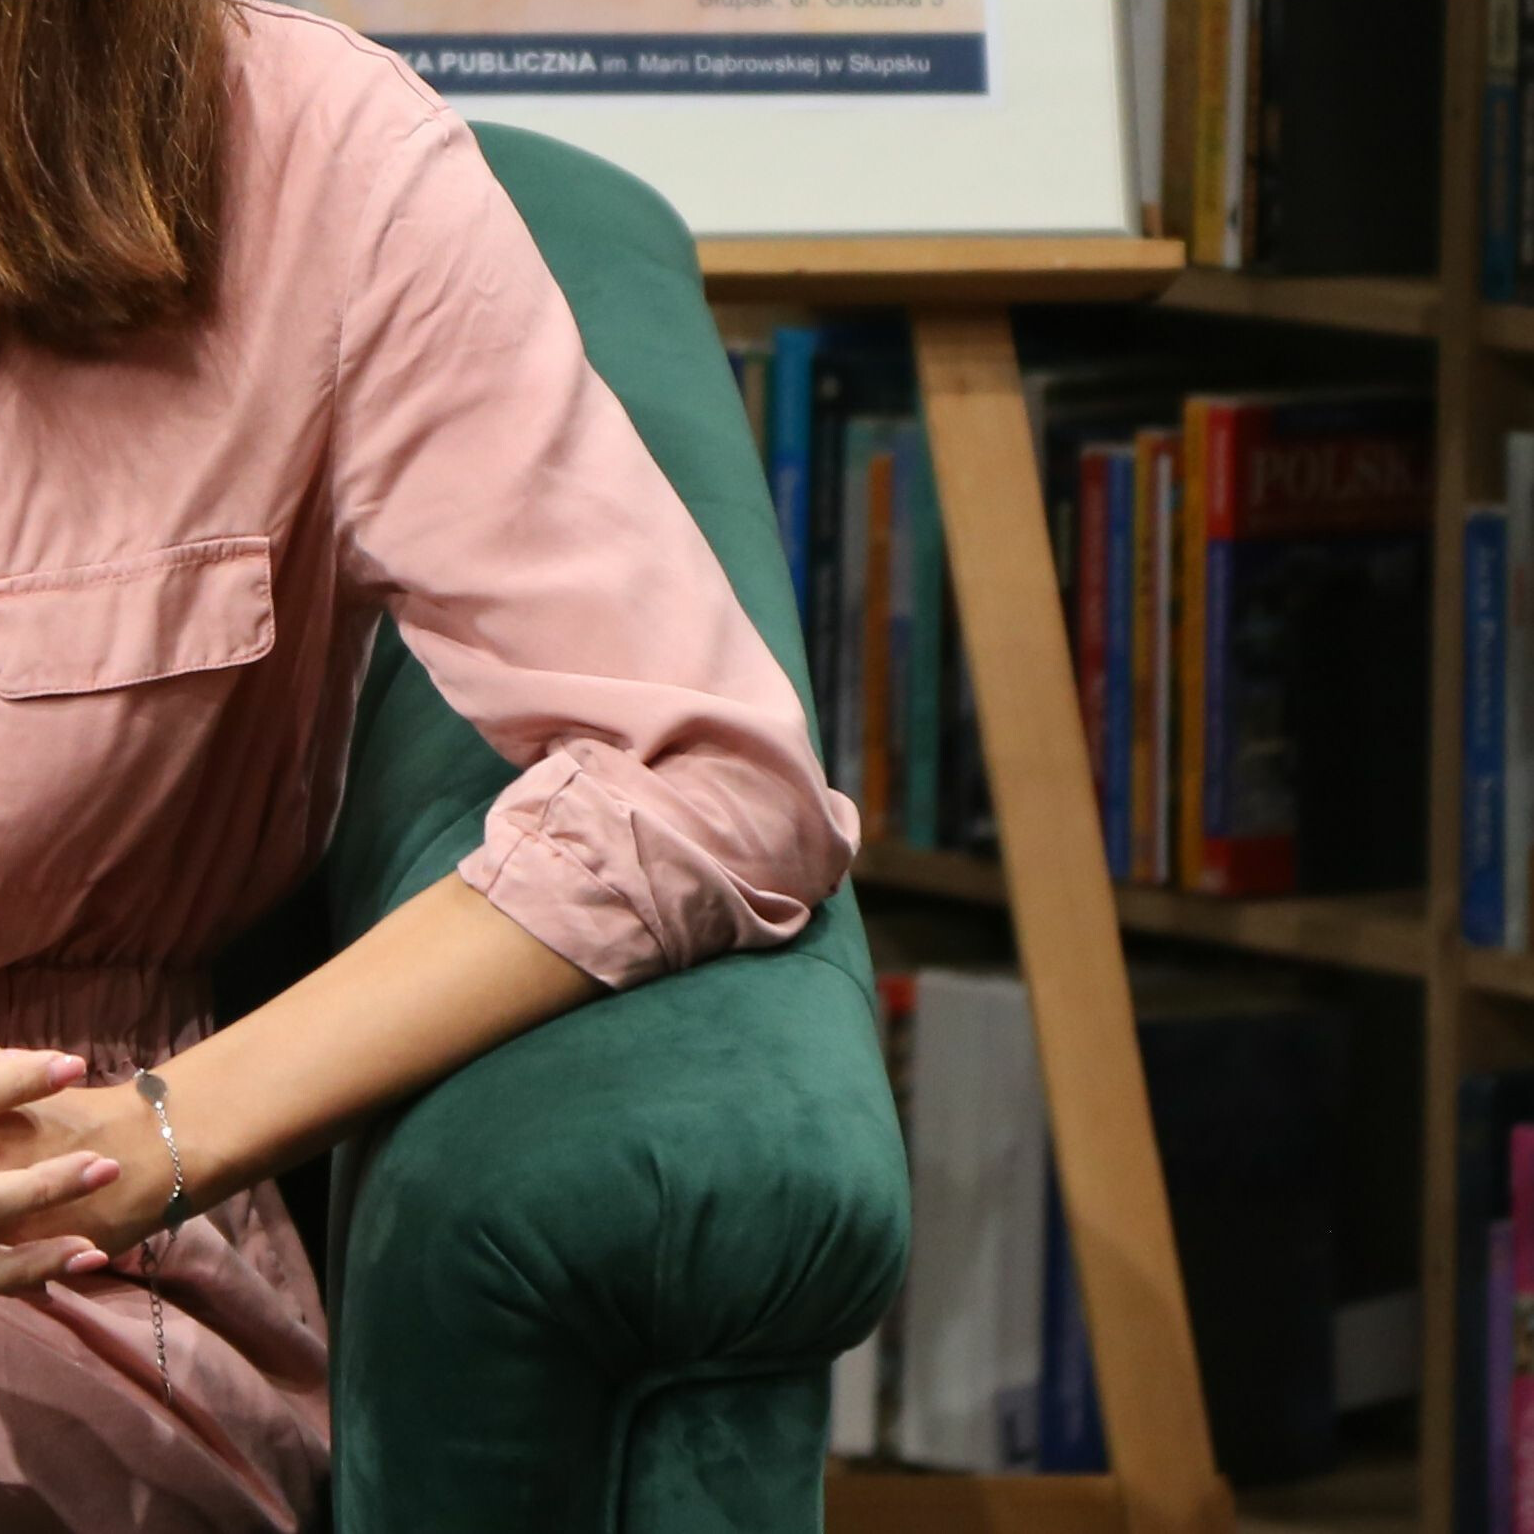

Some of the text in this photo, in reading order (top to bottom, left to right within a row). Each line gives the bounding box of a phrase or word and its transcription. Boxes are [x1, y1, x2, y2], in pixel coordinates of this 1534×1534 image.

[438, 50, 598, 74] PUBLICZNA
[637, 52, 691, 73] Marii
[694, 54, 822, 78] Dąbrowskiej
[825, 58, 844, 73] w
[848, 53, 932, 77] Słupsku
